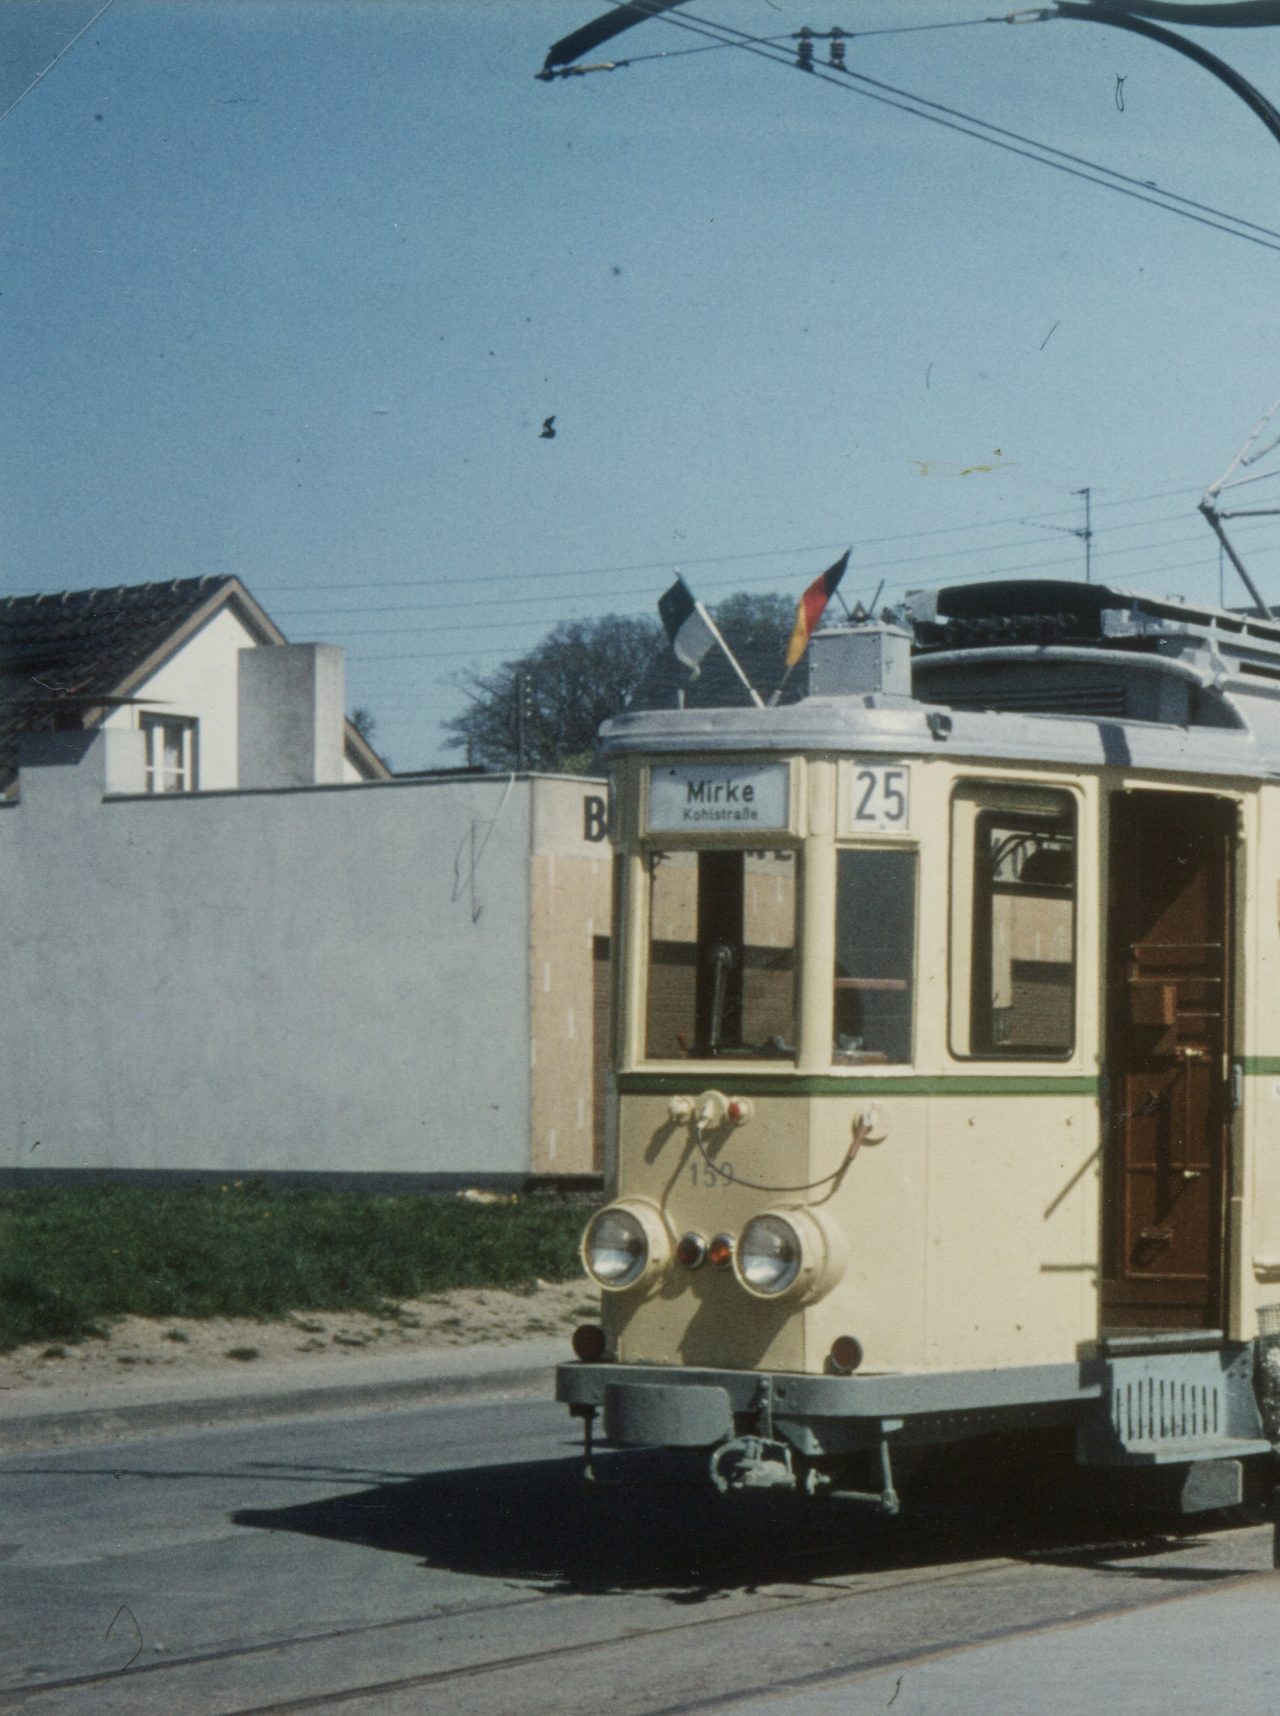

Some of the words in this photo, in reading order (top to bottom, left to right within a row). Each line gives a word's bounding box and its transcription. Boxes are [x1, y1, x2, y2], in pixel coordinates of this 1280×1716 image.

[686, 780, 755, 804] Mirke
[855, 770, 906, 821] 25
[682, 807, 758, 822] Kohlstraße
[690, 1161, 734, 1188] 159
